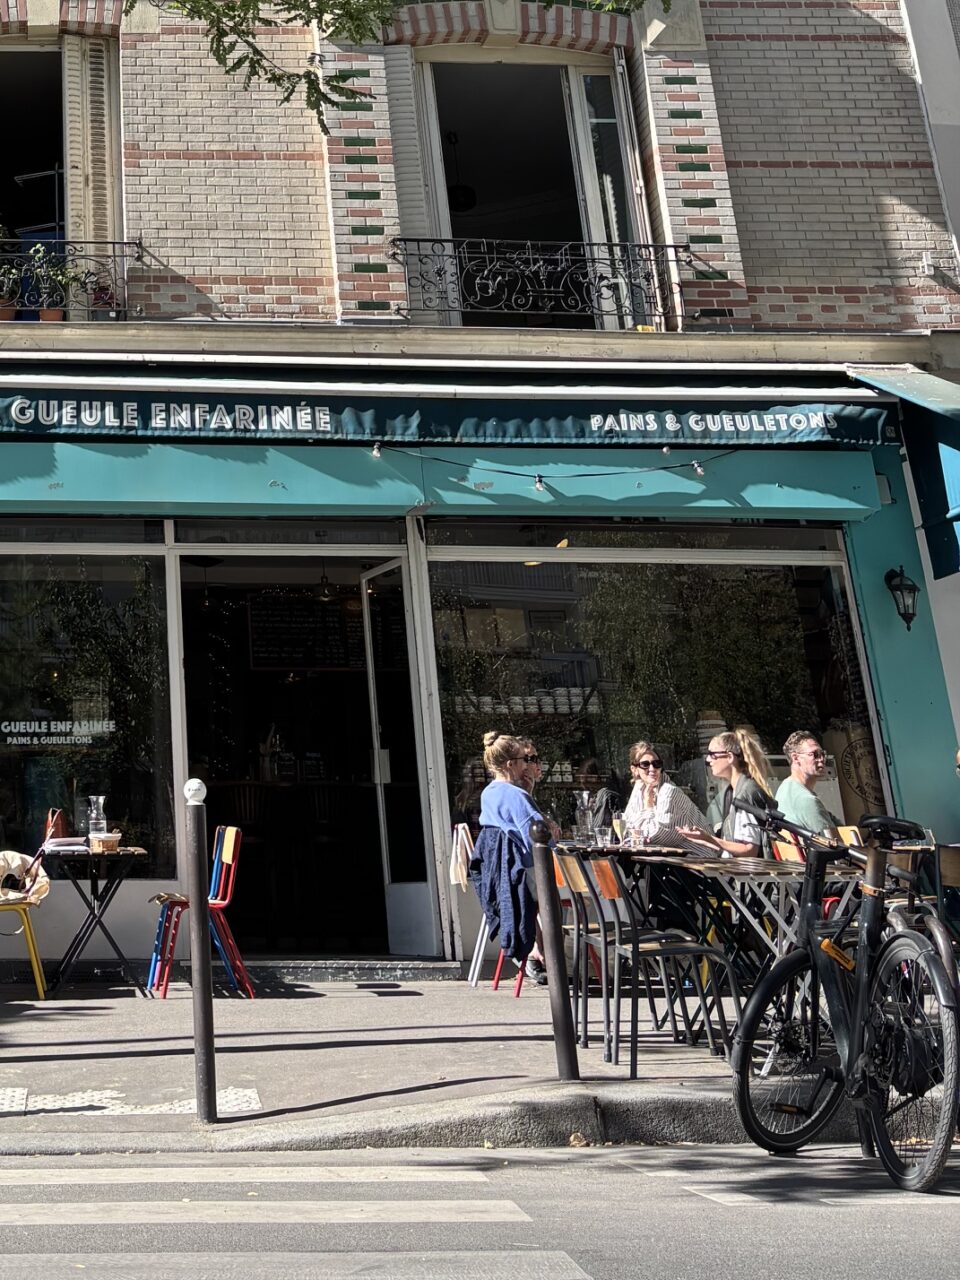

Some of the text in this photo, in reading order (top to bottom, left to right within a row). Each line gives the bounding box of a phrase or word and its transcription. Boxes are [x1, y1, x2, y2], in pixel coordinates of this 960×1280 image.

[11, 399, 139, 427] GUEULE
[151, 401, 331, 431] ENFARINÉE
[590, 412, 838, 432] PAINS & GUEULETONS
[1, 721, 48, 733] GUEULE
[6, 736, 93, 745] PAINS & GUEULETONS
